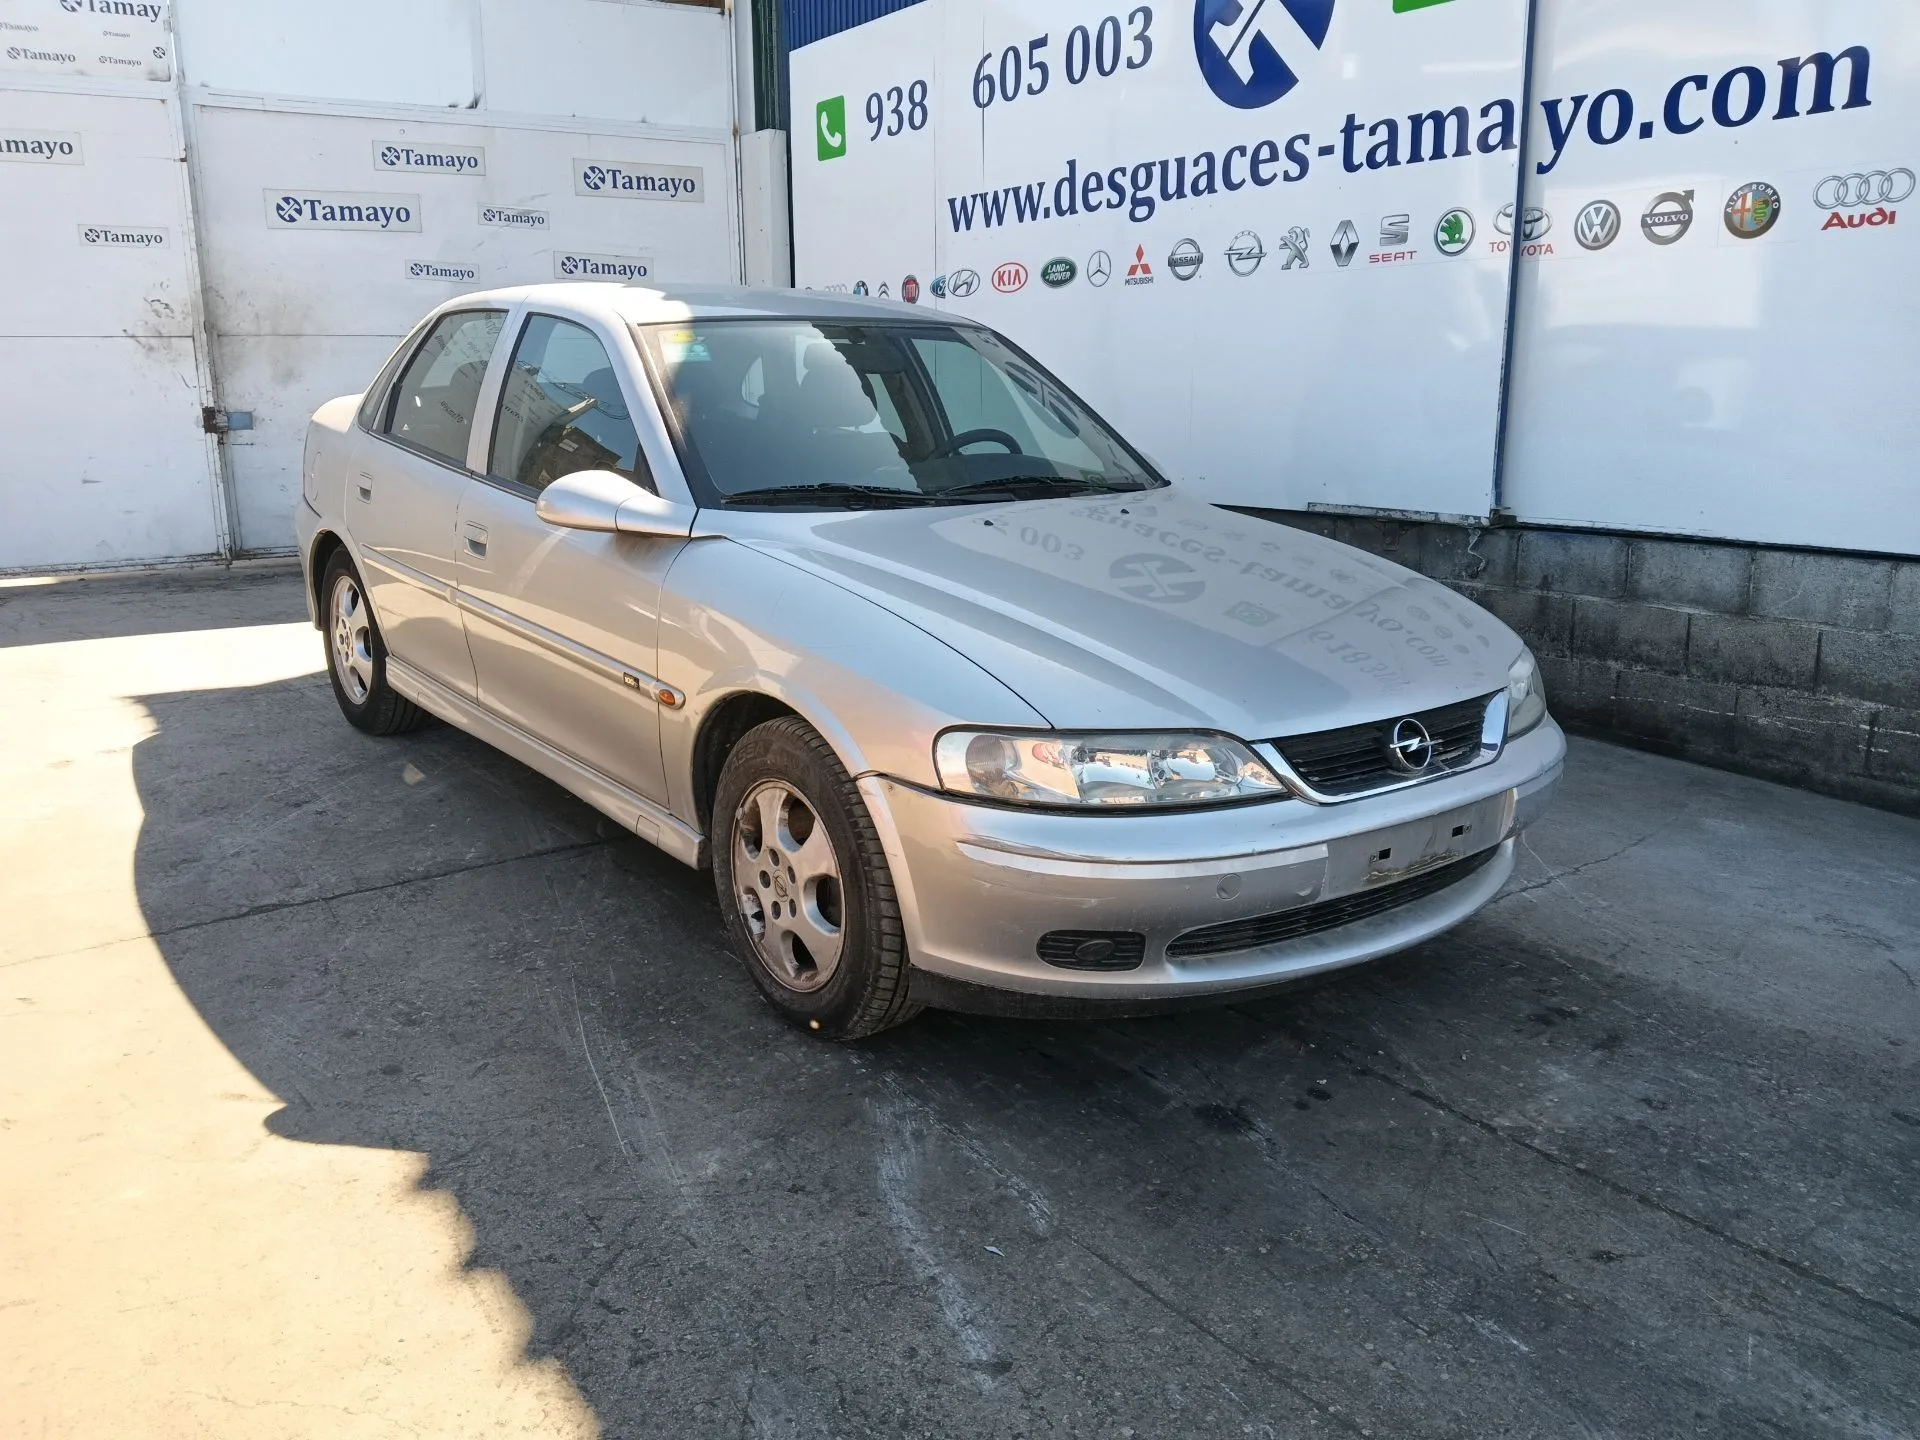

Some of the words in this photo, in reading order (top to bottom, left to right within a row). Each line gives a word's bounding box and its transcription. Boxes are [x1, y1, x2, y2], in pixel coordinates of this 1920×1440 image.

[20, 48, 76, 65] Tamayo
[107, 56, 142, 67] Tamayo
[865, 79, 929, 141] 938
[972, 33, 1050, 109] 605
[1065, 5, 1153, 85] 003
[401, 148, 478, 172] Tamayo
[606, 168, 696, 197] Tamayo
[1726, 189, 1744, 213] ALFA
[1751, 184, 1779, 209] ROMEO
[303, 199, 411, 228] Tamayo
[496, 210, 545, 227] Tamayo
[1645, 213, 1689, 224] VOLVO
[101, 229, 163, 247] Tamayo
[1172, 255, 1200, 264] NISSAN
[1369, 251, 1417, 263] SEAT
[423, 264, 475, 280] Tamayo
[578, 258, 648, 279] Tamayo
[997, 268, 1022, 287] KIA
[1125, 276, 1154, 286] MITSUBISHI
